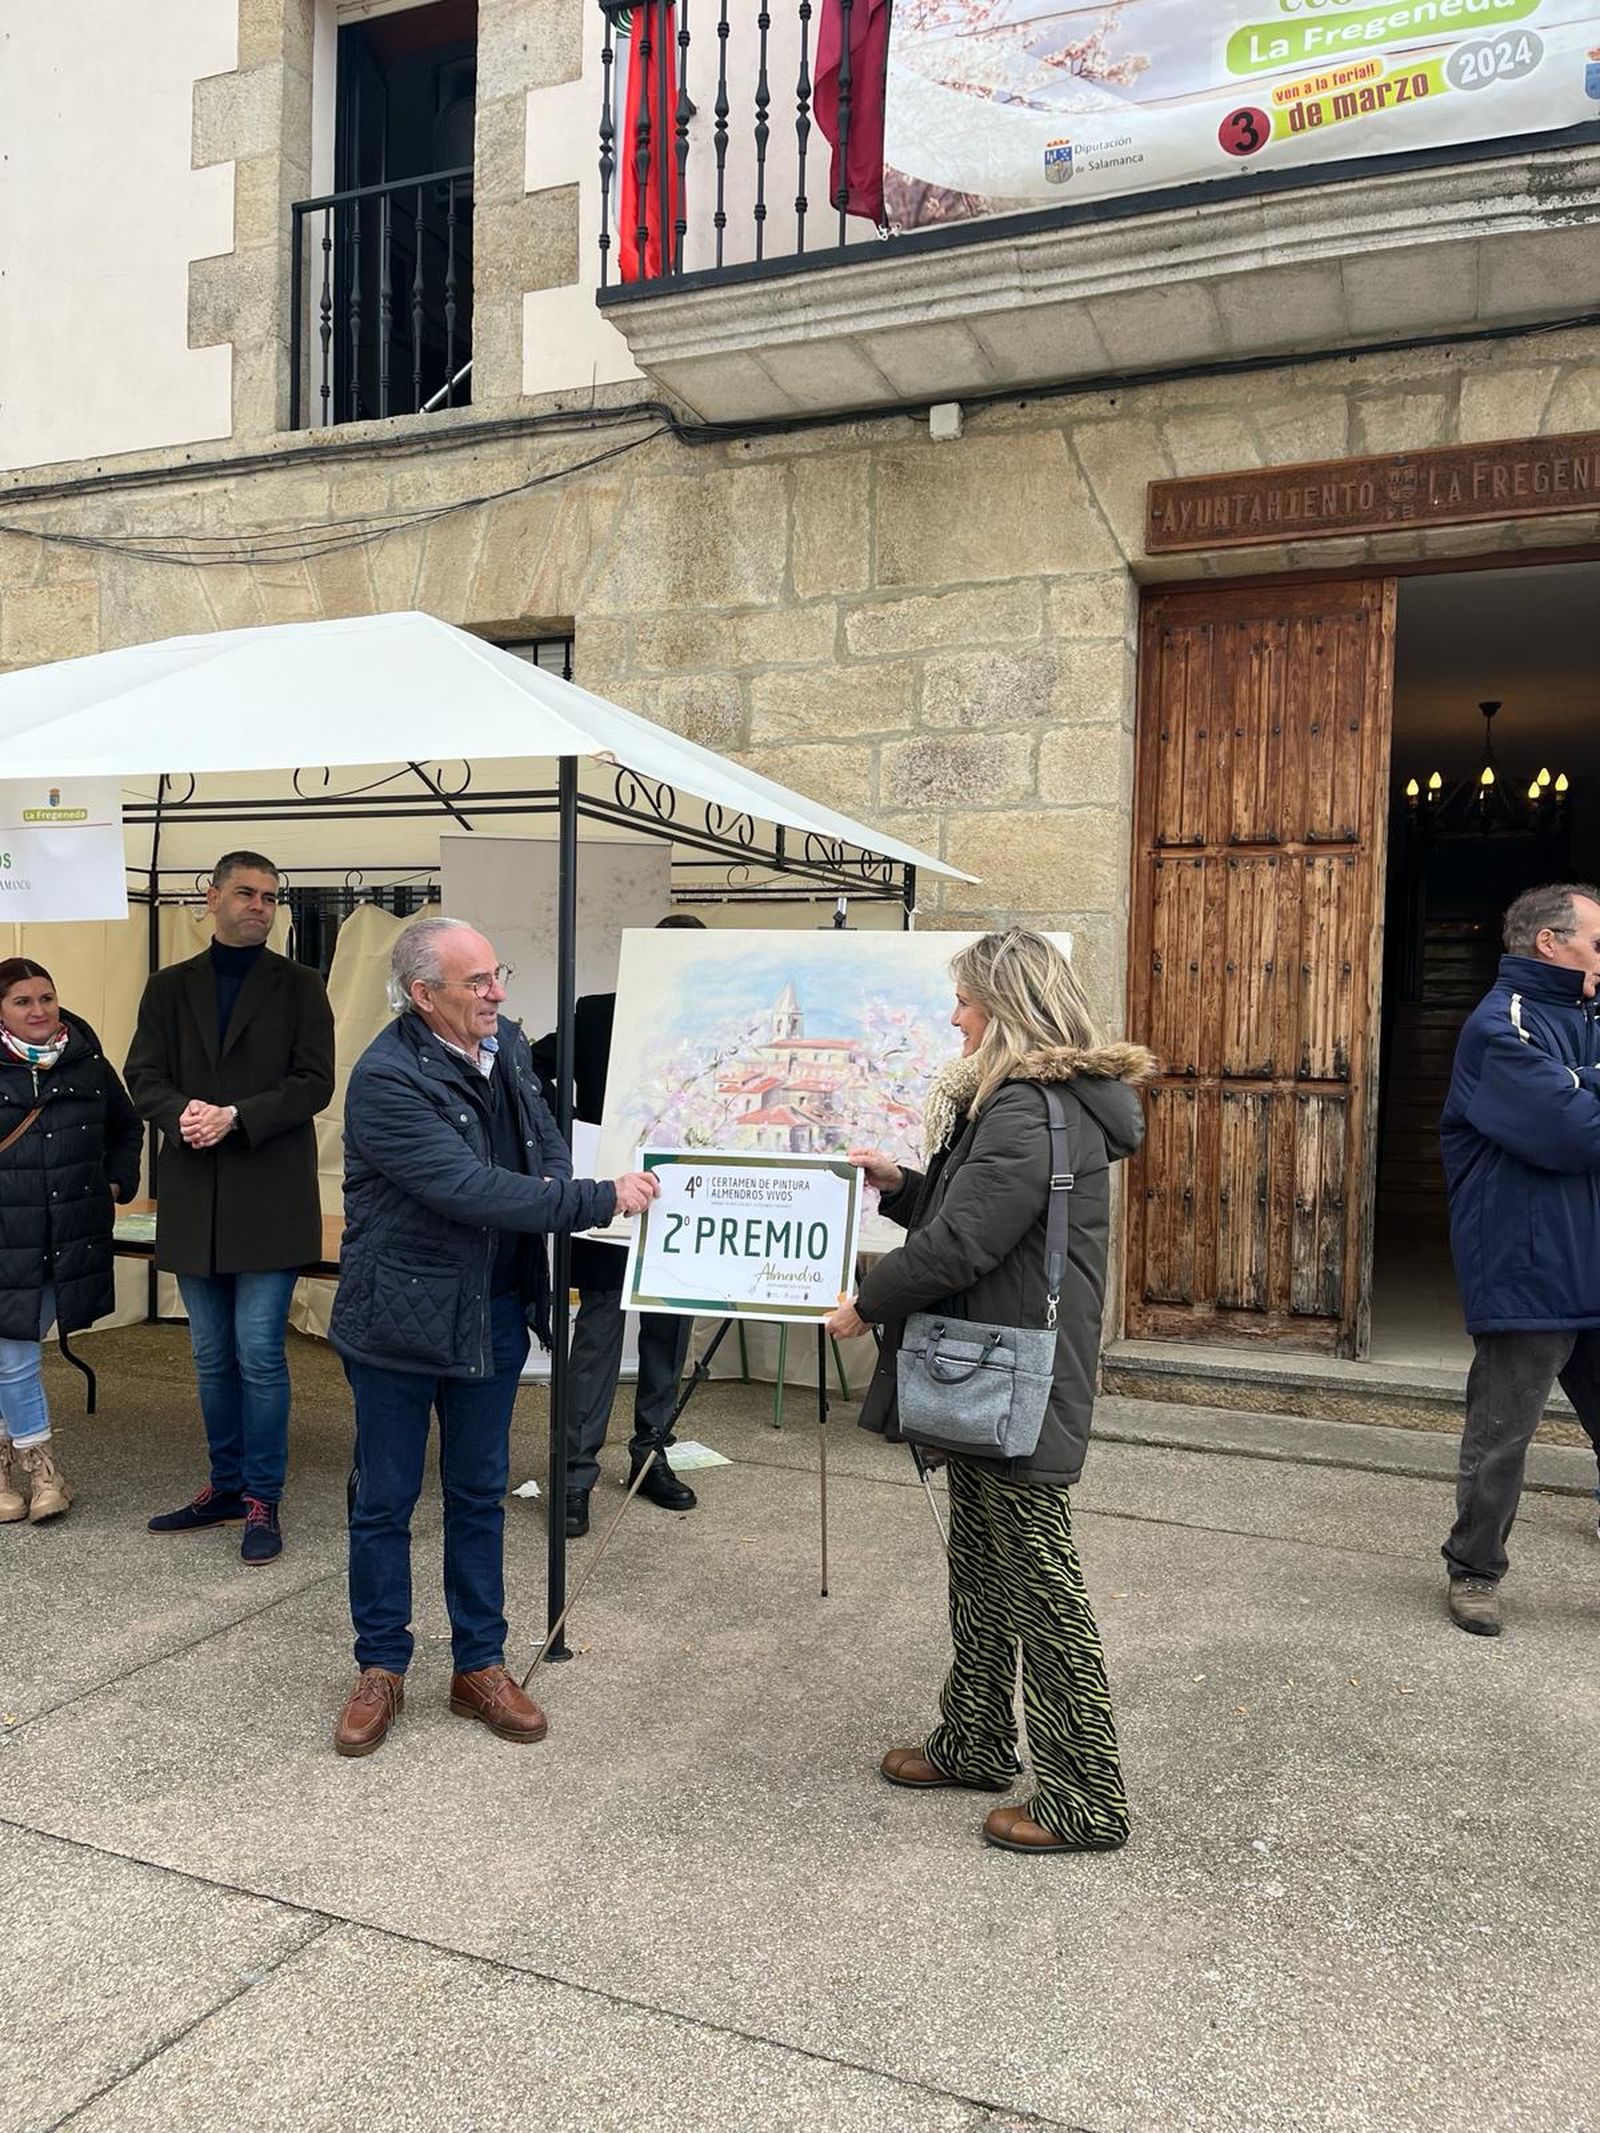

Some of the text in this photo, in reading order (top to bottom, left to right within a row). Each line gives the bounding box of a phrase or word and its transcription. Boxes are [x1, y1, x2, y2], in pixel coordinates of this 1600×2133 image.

[1250, 35, 1290, 62] La
[1231, 36, 1533, 151] 3 de marzo 2024
[1276, 86, 1300, 102] ven
[1304, 83, 1312, 95] a
[1316, 78, 1328, 92] la
[1074, 137, 1132, 155] Diputación
[1088, 154, 1144, 171] Salamanca
[1429, 467, 1462, 504] LA
[711, 1176, 757, 1189] CERTAMEN
[759, 1179, 770, 1189] DE
[772, 1179, 810, 1191] PINTURA
[711, 1188, 793, 1201] ALMENDROS VIVOS
[695, 1216, 828, 1261] PREMIO
